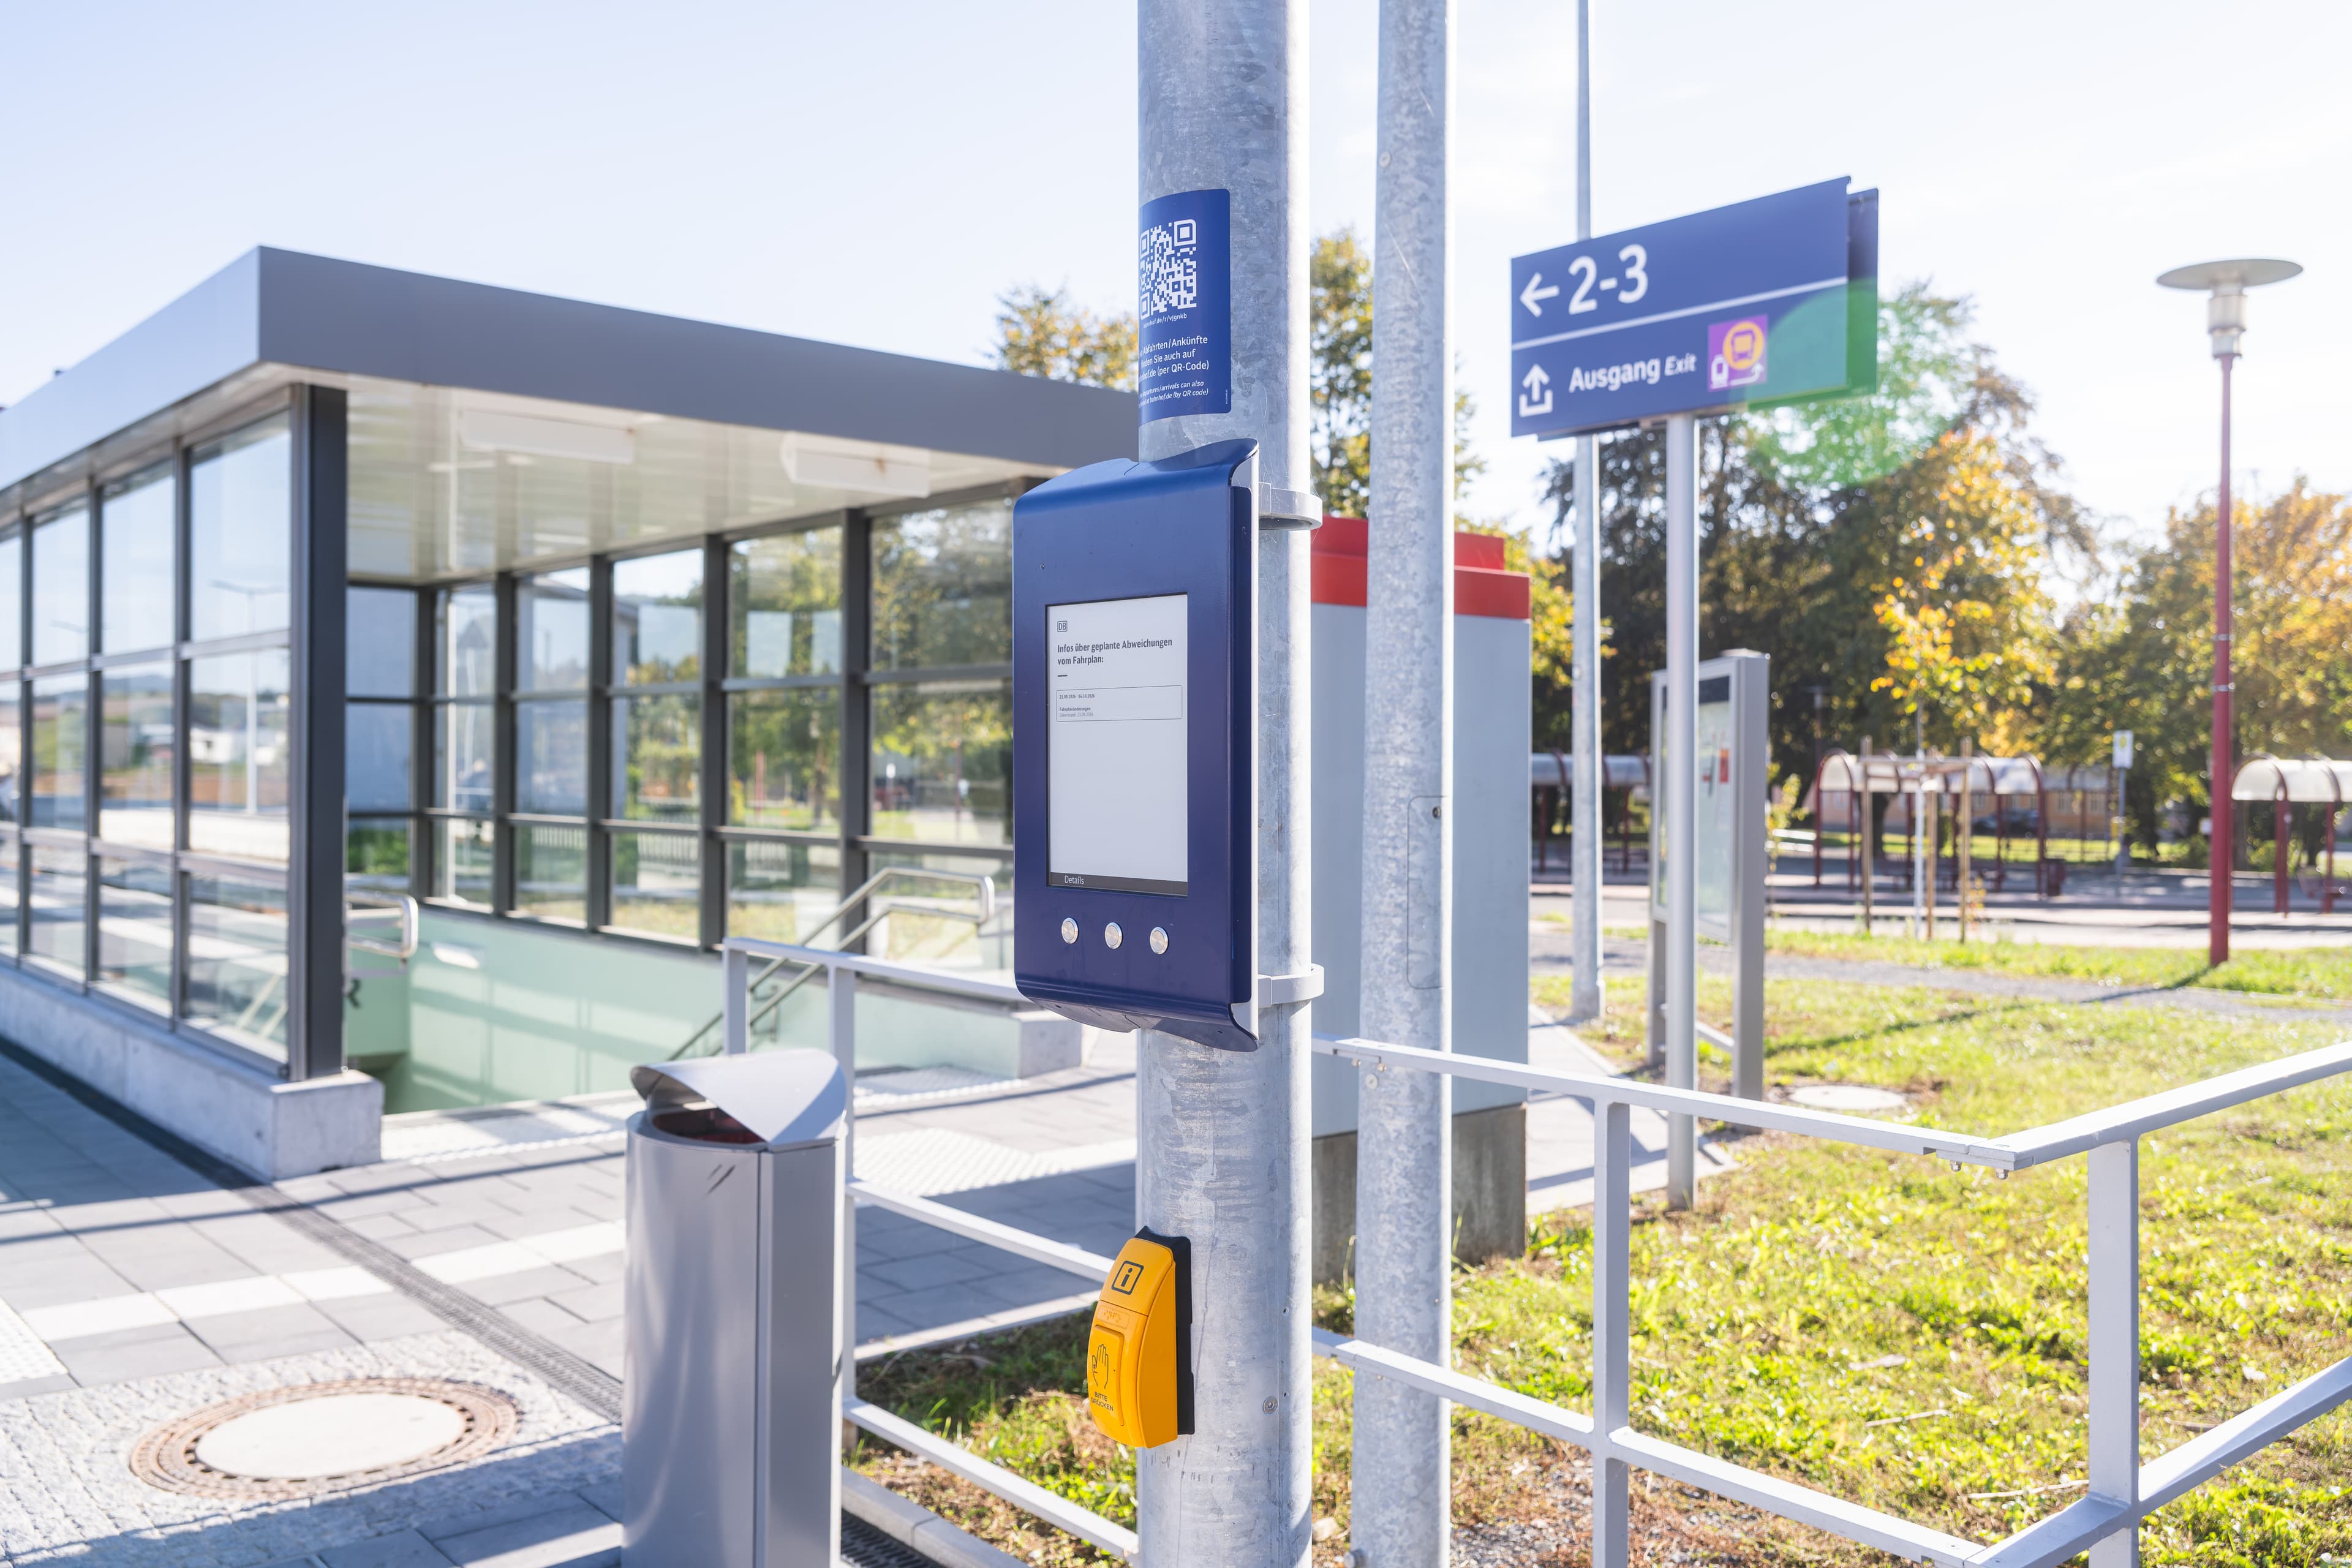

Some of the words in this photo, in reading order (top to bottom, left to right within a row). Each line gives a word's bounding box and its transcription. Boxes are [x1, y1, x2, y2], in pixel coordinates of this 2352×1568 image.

[1567, 243, 1649, 315] 2-3
[1154, 355, 1163, 364] Sie
[1164, 350, 1180, 361] auch
[1182, 349, 1196, 358] auf
[1157, 366, 1170, 377] (per
[1171, 360, 1209, 373] QR-Code)
[1569, 358, 1660, 393] Ausgang
[1664, 353, 1697, 377] Exit
[1150, 393, 1172, 403] bahnhof.de
[1058, 622, 1067, 631] DB
[1058, 644, 1074, 653] Infos
[1091, 642, 1120, 653] geplante
[1122, 638, 1172, 649] Abweichungen
[1072, 655, 1104, 666] Fahrplan:
[1065, 875, 1084, 884] Details
[1091, 1396, 1114, 1412] DRÜCKEN
[1095, 1391, 1107, 1402] BITTE
